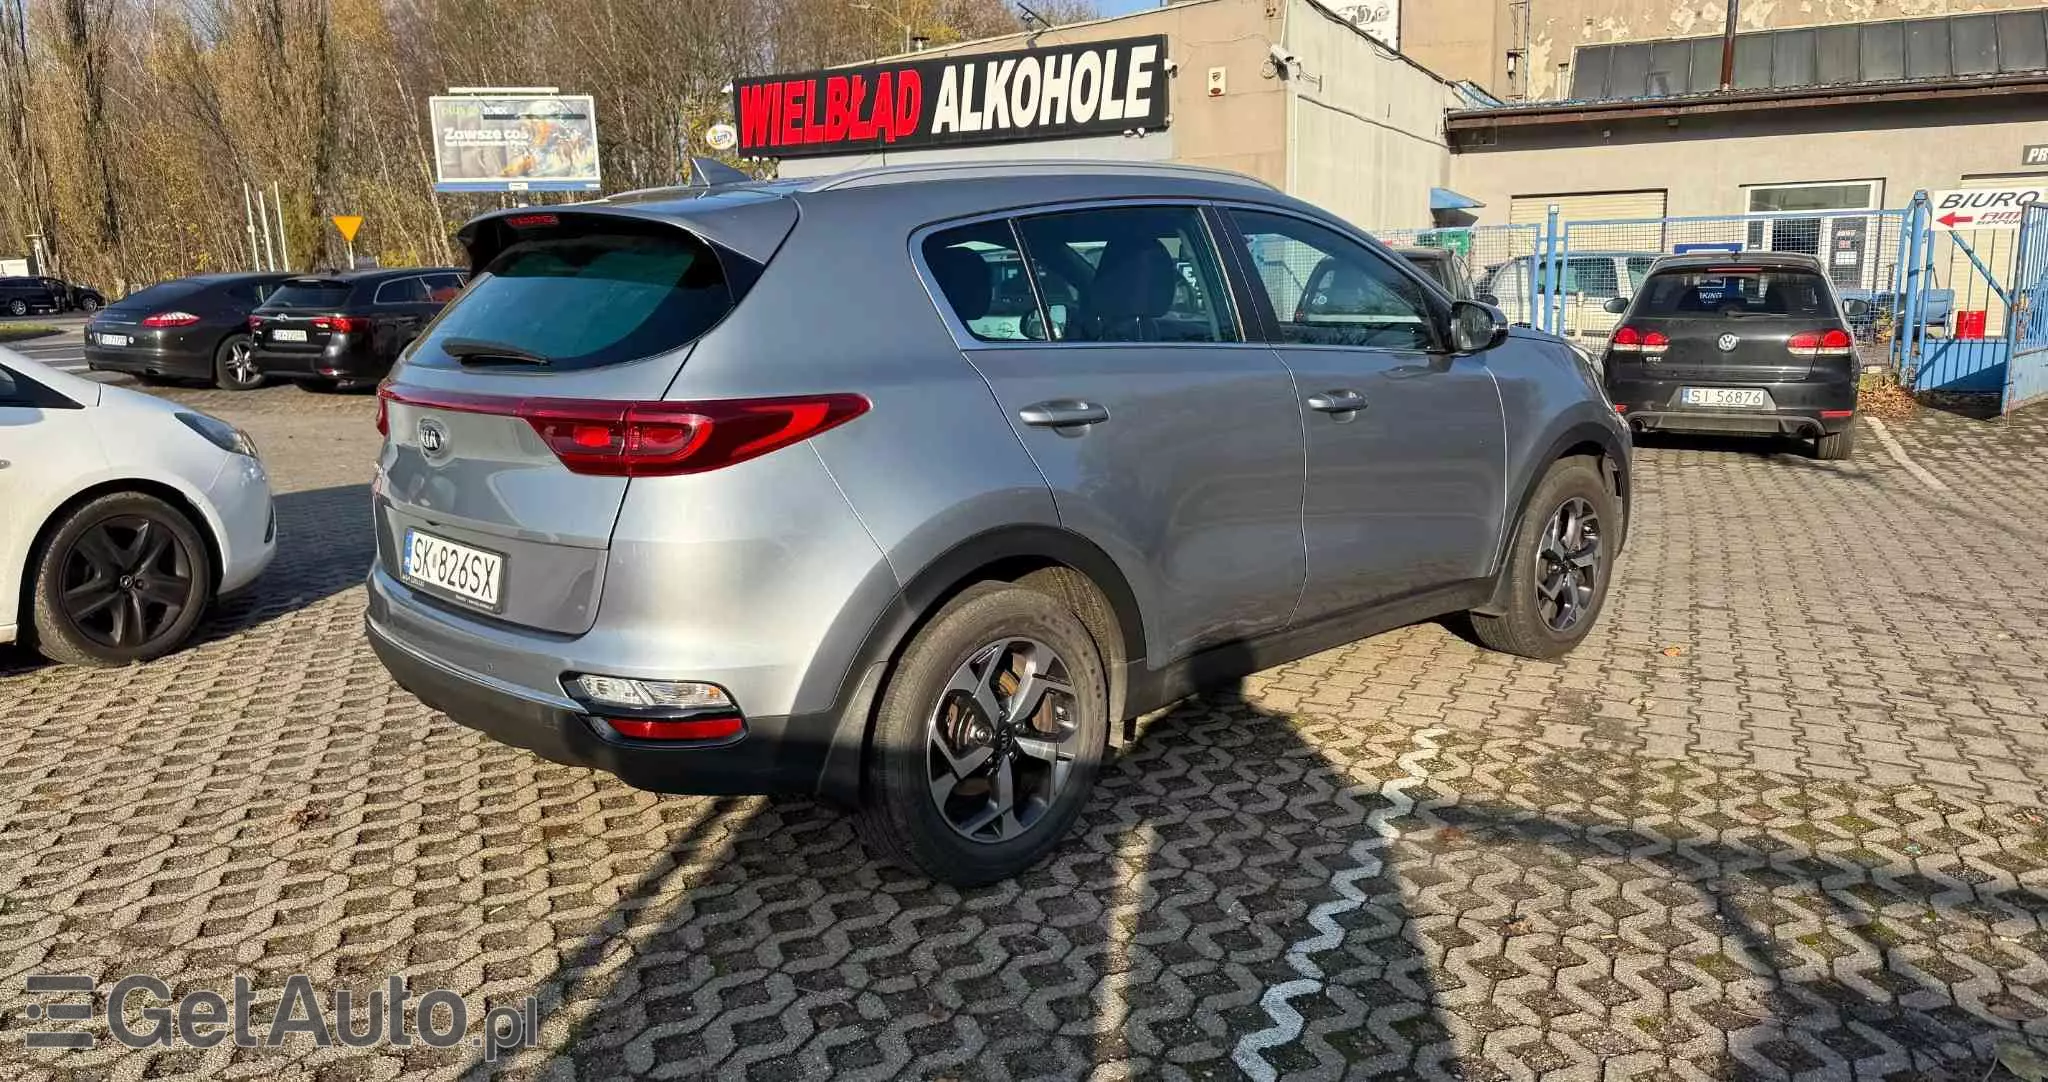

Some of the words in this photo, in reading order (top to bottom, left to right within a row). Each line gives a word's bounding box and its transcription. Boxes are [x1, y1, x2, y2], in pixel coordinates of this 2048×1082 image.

[740, 69, 923, 148] WIELBŁĄD
[931, 45, 1158, 135] ALKOHOLE
[1938, 190, 2040, 209] BIURO
[1691, 390, 1709, 403] SI
[1717, 391, 1761, 404] 56876
[413, 537, 435, 579] SK
[438, 546, 495, 599] 826SX
